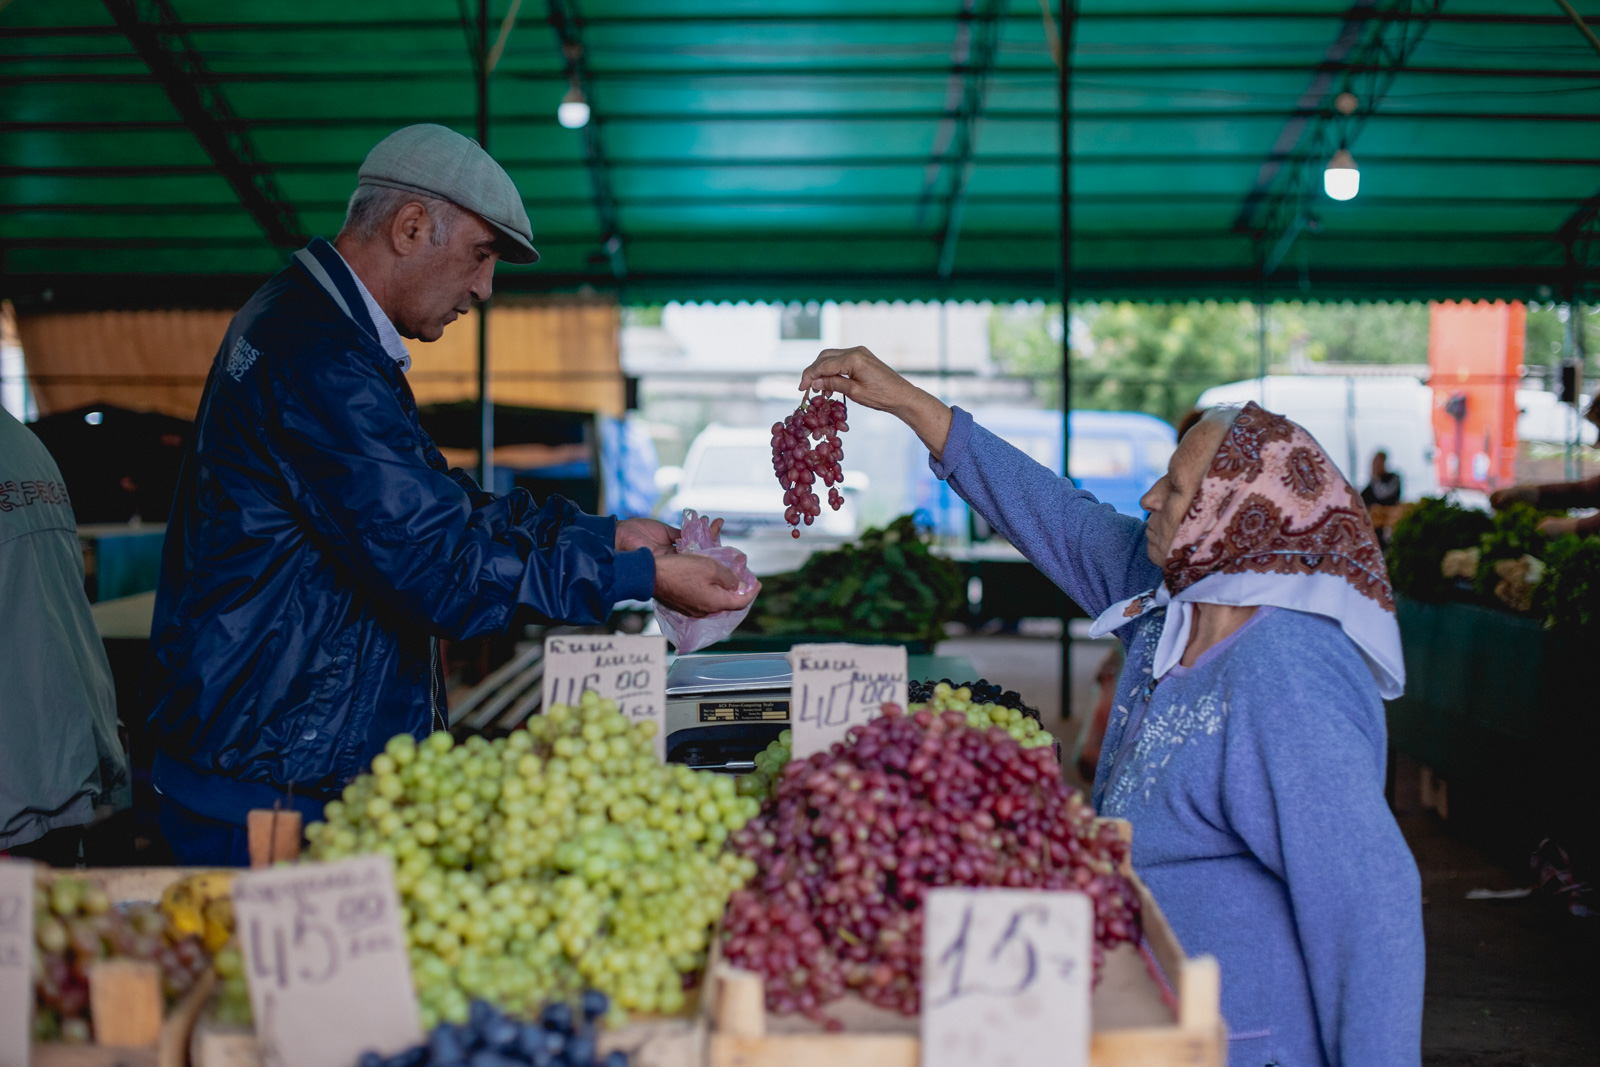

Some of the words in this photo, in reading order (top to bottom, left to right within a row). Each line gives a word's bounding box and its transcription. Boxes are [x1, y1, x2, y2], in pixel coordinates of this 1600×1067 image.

[226, 358, 245, 382] 982
[615, 669, 651, 691] 00
[799, 679, 855, 729] 40
[249, 900, 340, 989] 45
